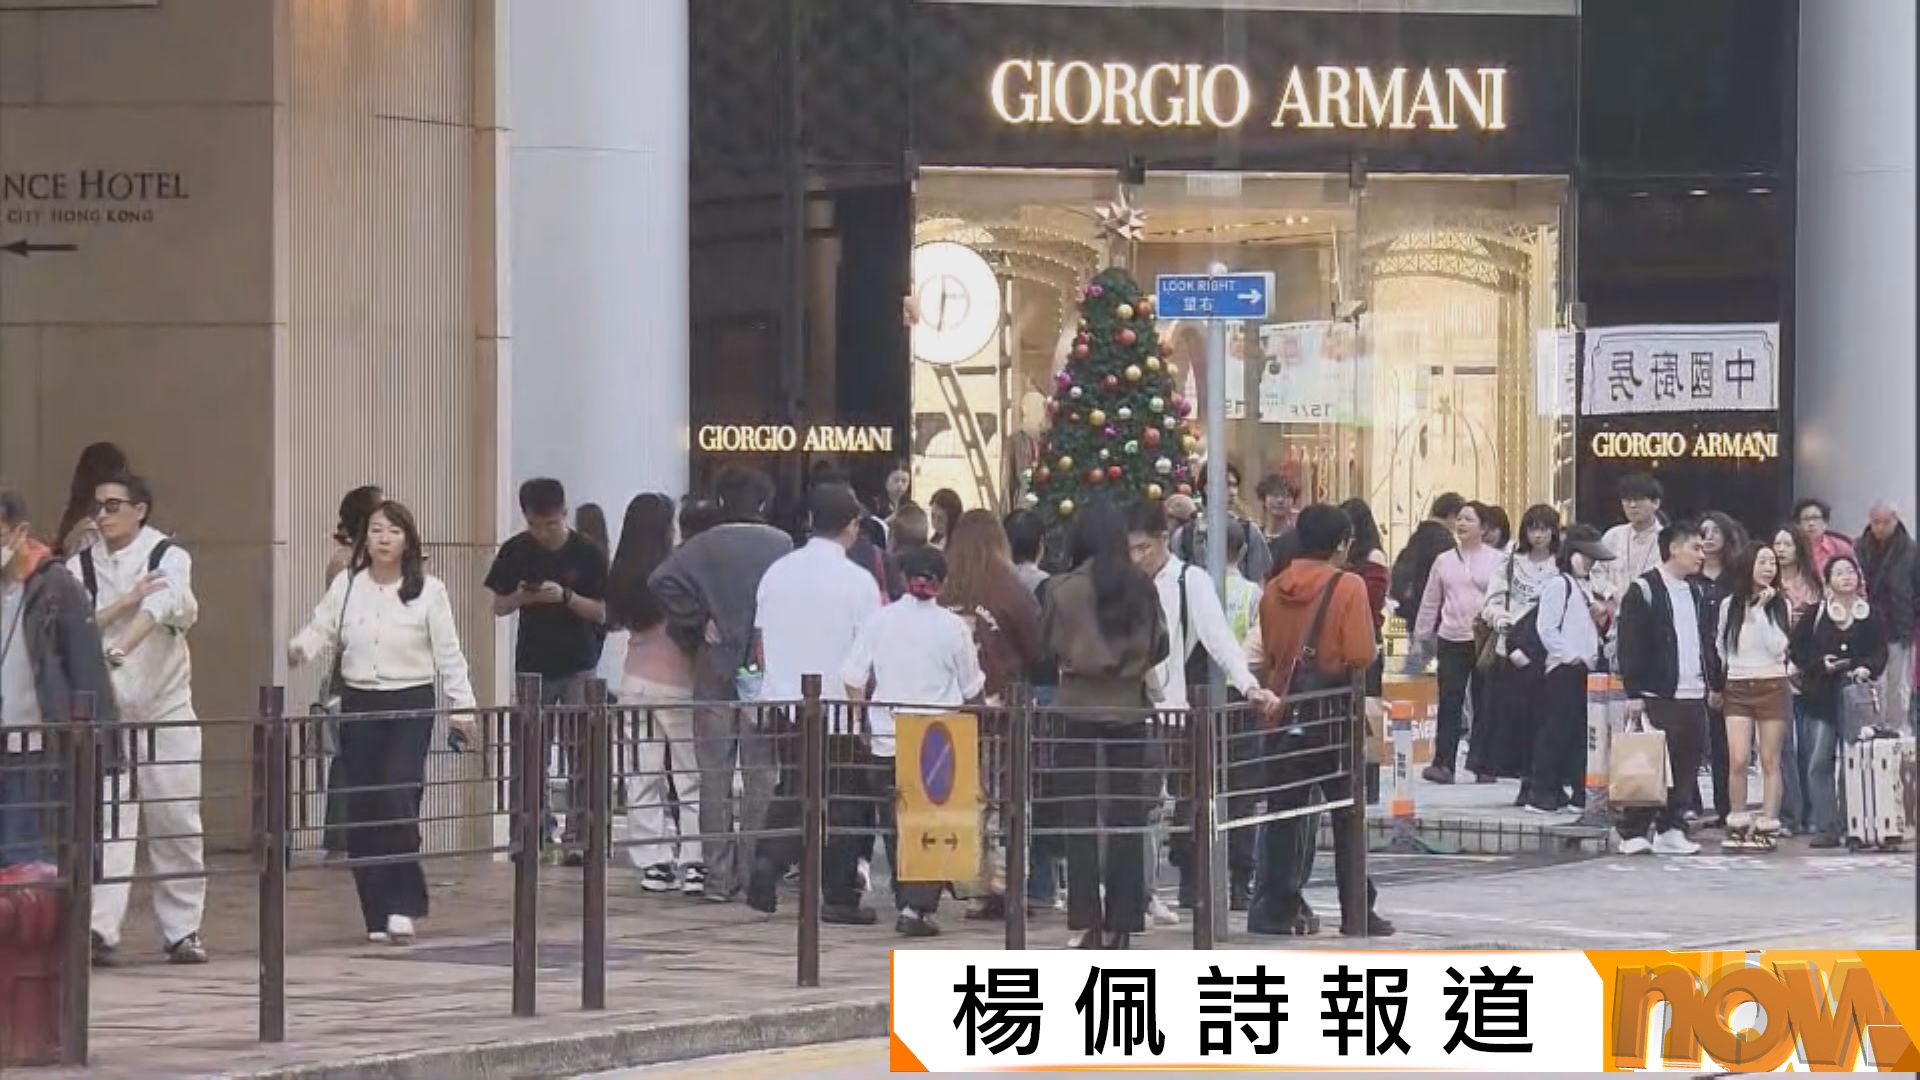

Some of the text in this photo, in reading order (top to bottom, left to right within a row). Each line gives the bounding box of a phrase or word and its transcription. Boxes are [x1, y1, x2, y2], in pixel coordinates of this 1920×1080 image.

[990, 58, 1508, 131] GIORGIO ARMANI
[80, 170, 190, 200] HOTEL
[1162, 280, 1235, 292] LOOK RIGHT
[698, 424, 893, 452] GIORGIO ARMANI
[1592, 431, 1779, 459] GIORGIO ARMANI
